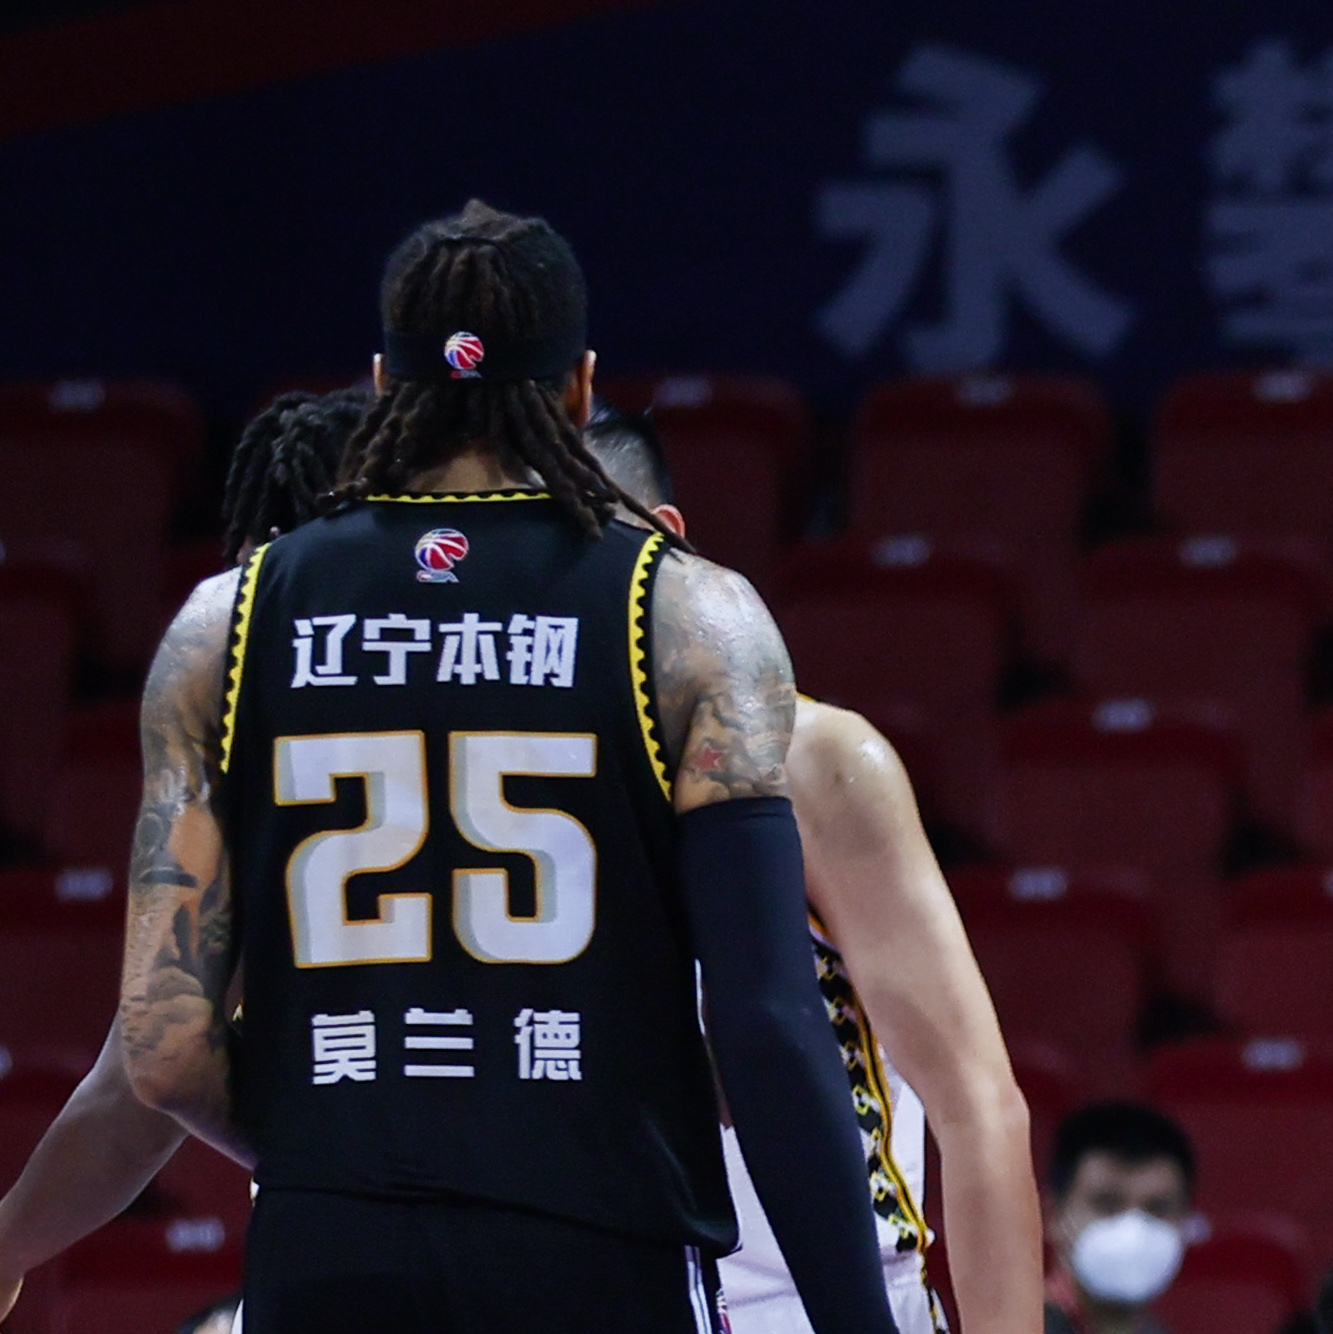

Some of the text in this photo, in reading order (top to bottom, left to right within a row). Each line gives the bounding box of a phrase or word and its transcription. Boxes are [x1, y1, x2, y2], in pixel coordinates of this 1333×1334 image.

[290, 612, 579, 689] 辽宁本钢
[273, 730, 598, 969] 25
[311, 1008, 583, 1086] 莫兰德
